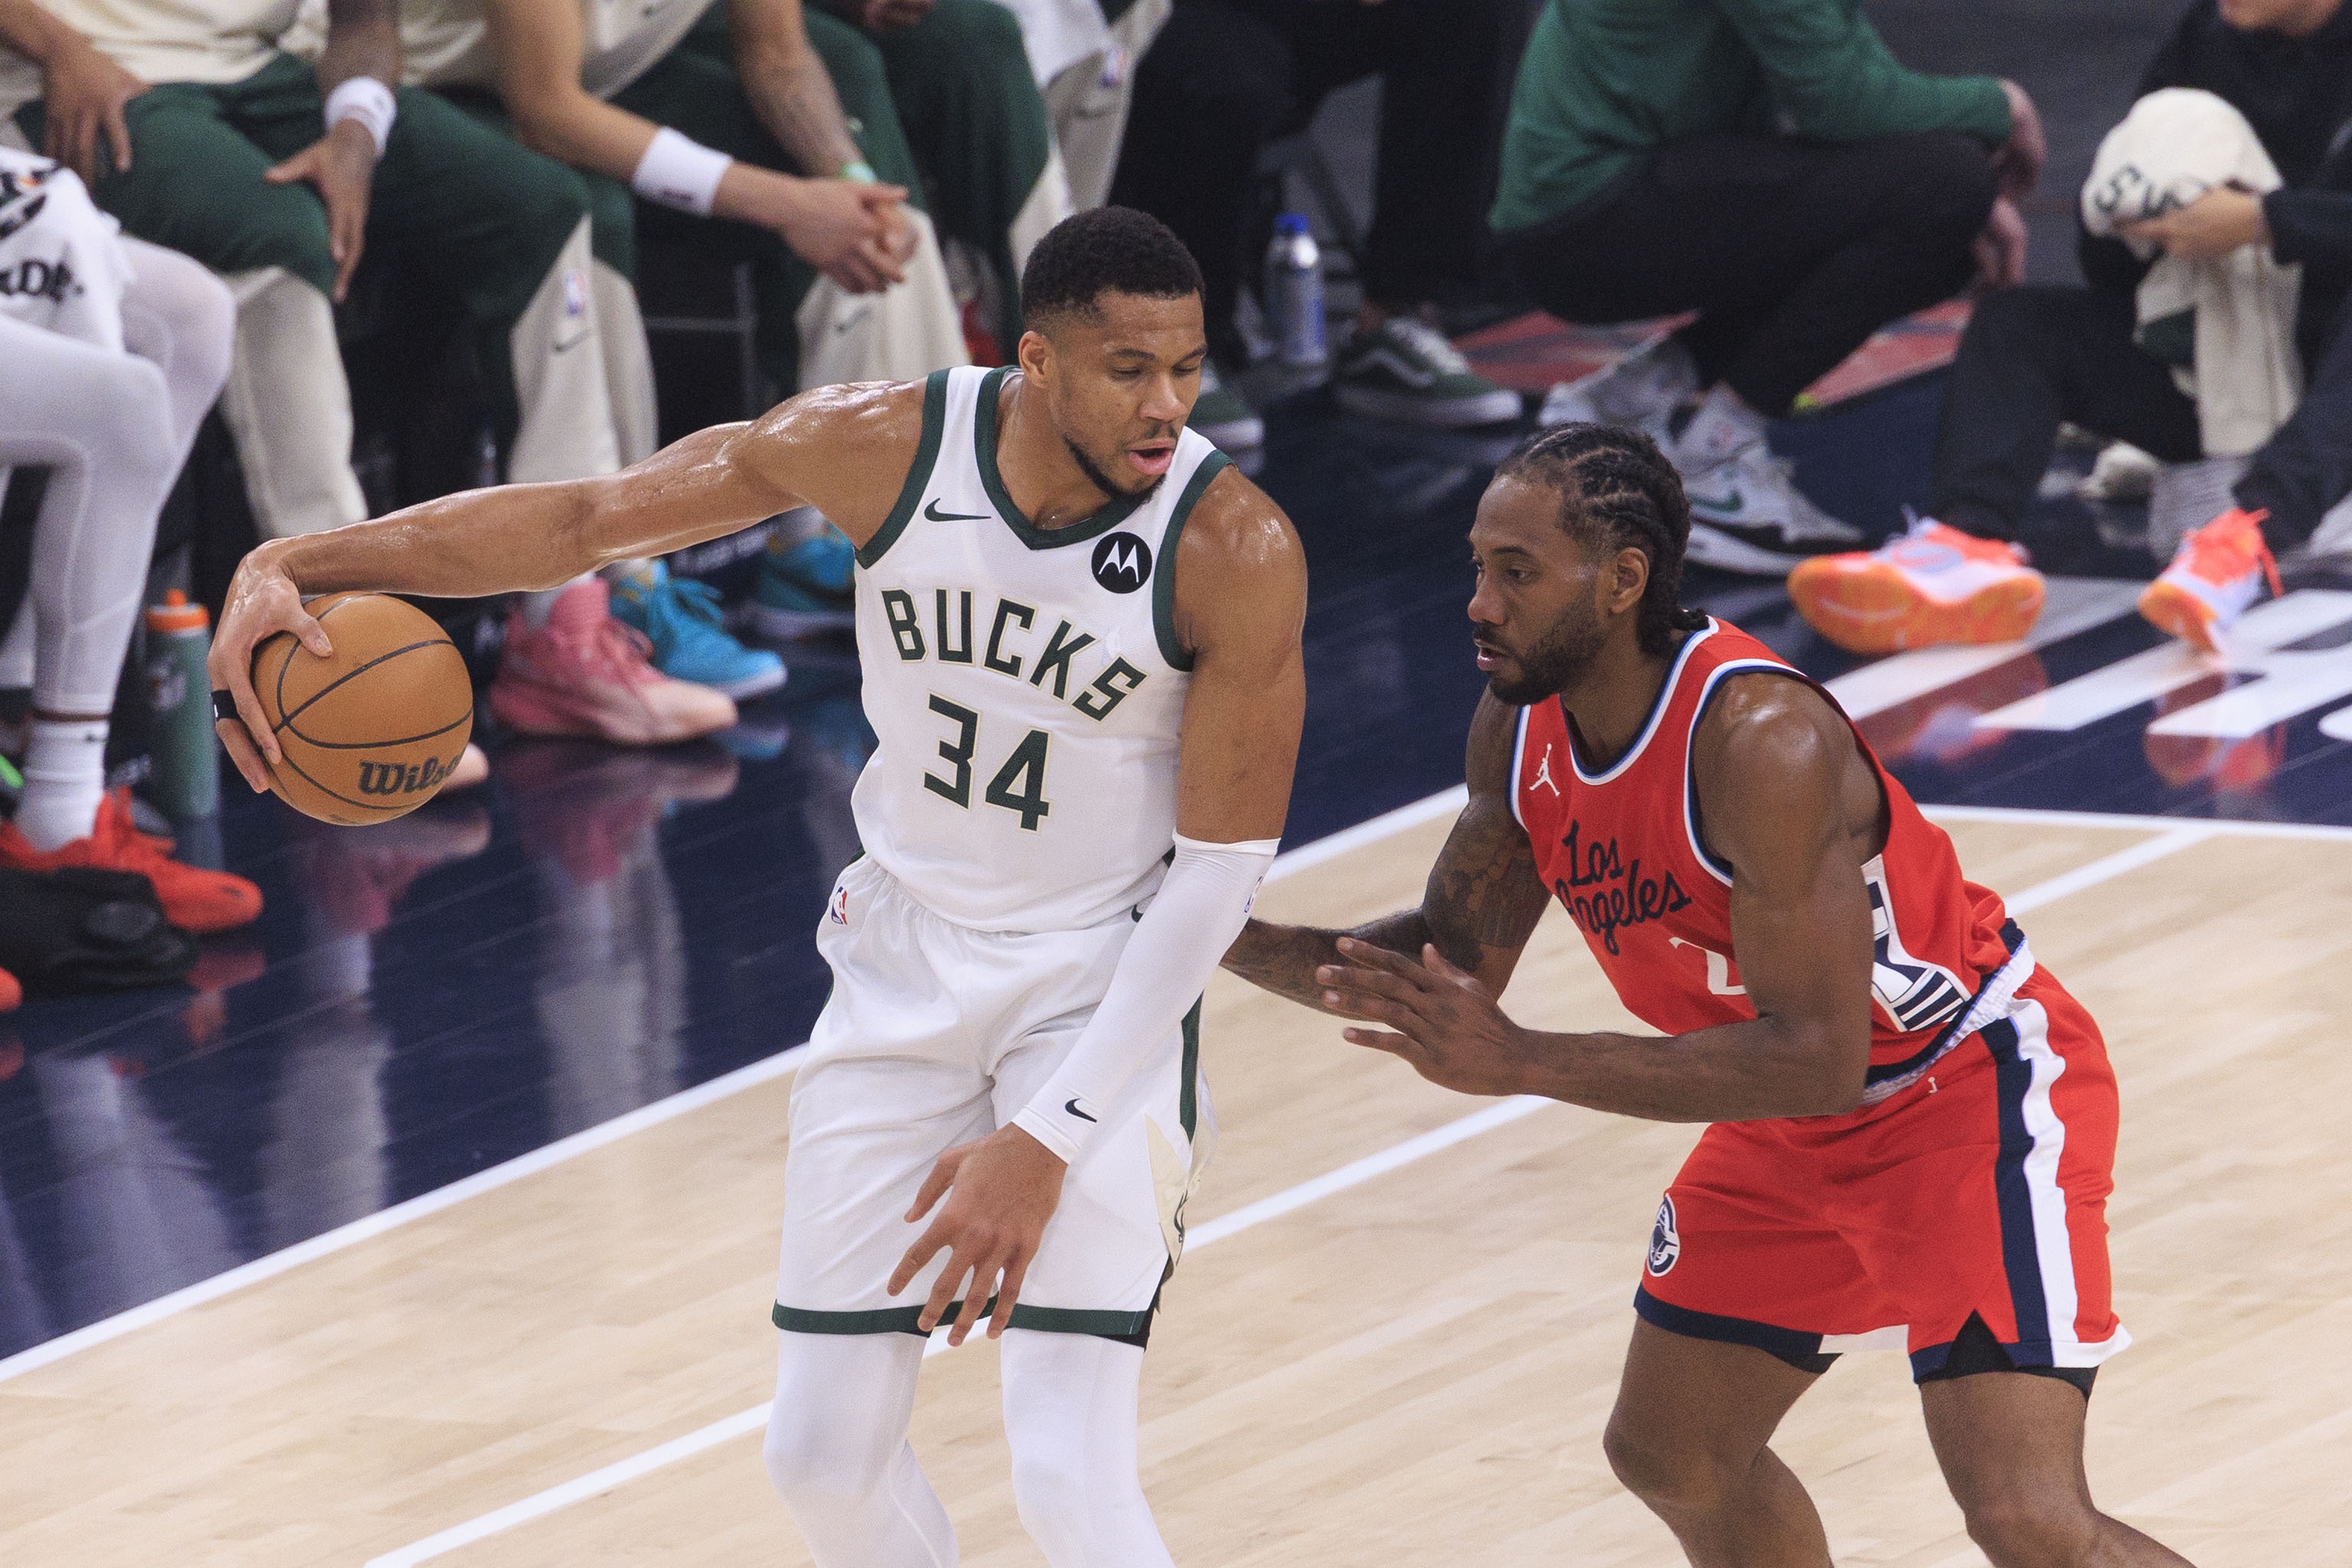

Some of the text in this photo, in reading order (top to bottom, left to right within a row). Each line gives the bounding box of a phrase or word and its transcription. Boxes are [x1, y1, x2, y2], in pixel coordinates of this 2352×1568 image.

[880, 588, 1148, 723] BUCKS
[923, 691, 1052, 833] 34
[1562, 818, 1624, 887] Los
